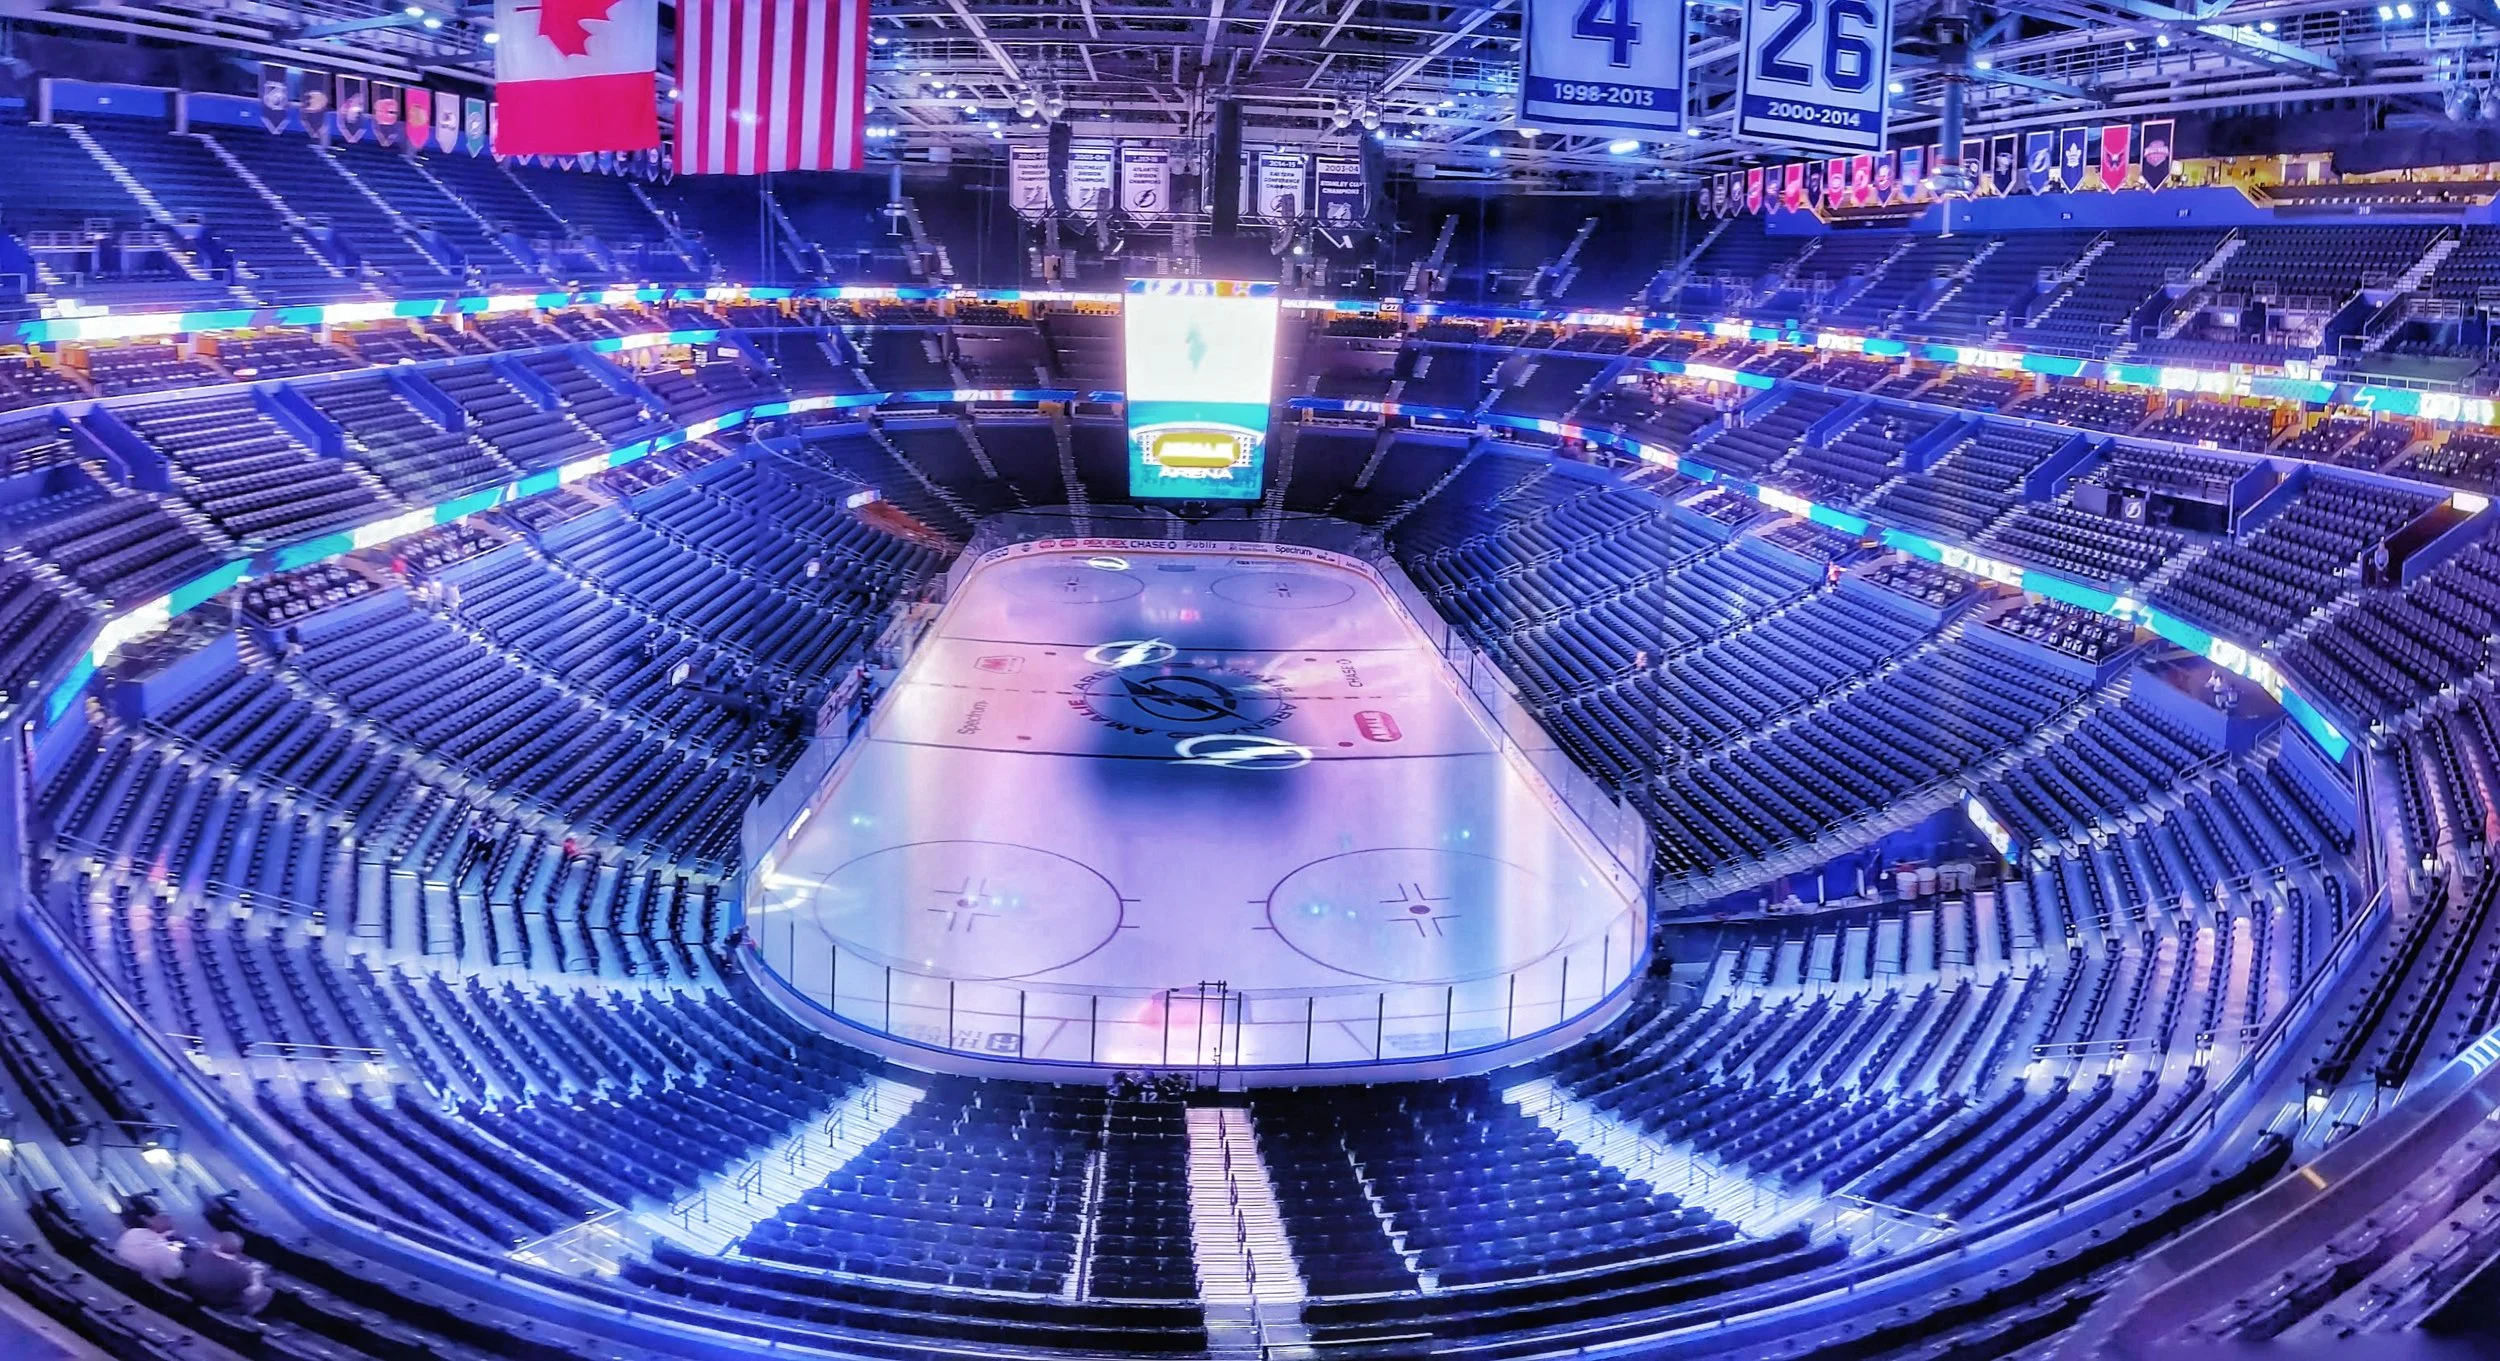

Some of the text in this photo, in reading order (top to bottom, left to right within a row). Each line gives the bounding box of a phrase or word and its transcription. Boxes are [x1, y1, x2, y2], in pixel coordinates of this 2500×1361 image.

[1572, 0, 1643, 69] 4
[1755, 0, 1878, 94] 26
[1553, 82, 1655, 107] 1998-2013
[1767, 101, 1861, 127] 2000-2014
[1325, 164, 1359, 173] 2003-04
[1131, 540, 1166, 549] CHASE
[1275, 544, 1313, 557] Spectrum
